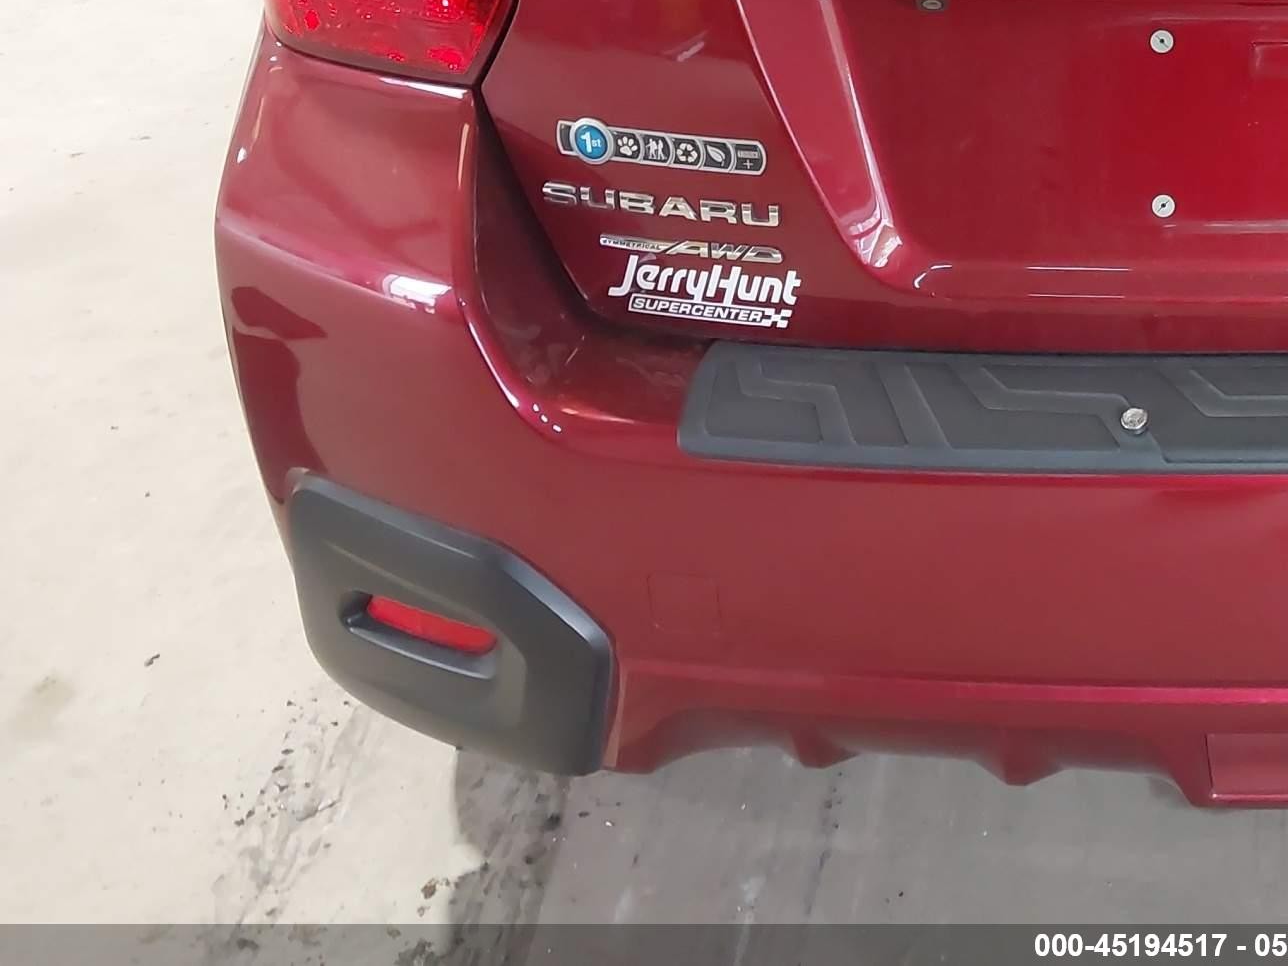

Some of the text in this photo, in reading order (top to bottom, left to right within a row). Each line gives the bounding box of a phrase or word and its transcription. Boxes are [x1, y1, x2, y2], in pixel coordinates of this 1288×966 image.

[542, 182, 779, 226] SUBARU
[666, 241, 783, 263] AWD
[632, 298, 763, 322] SUPERCENTER
